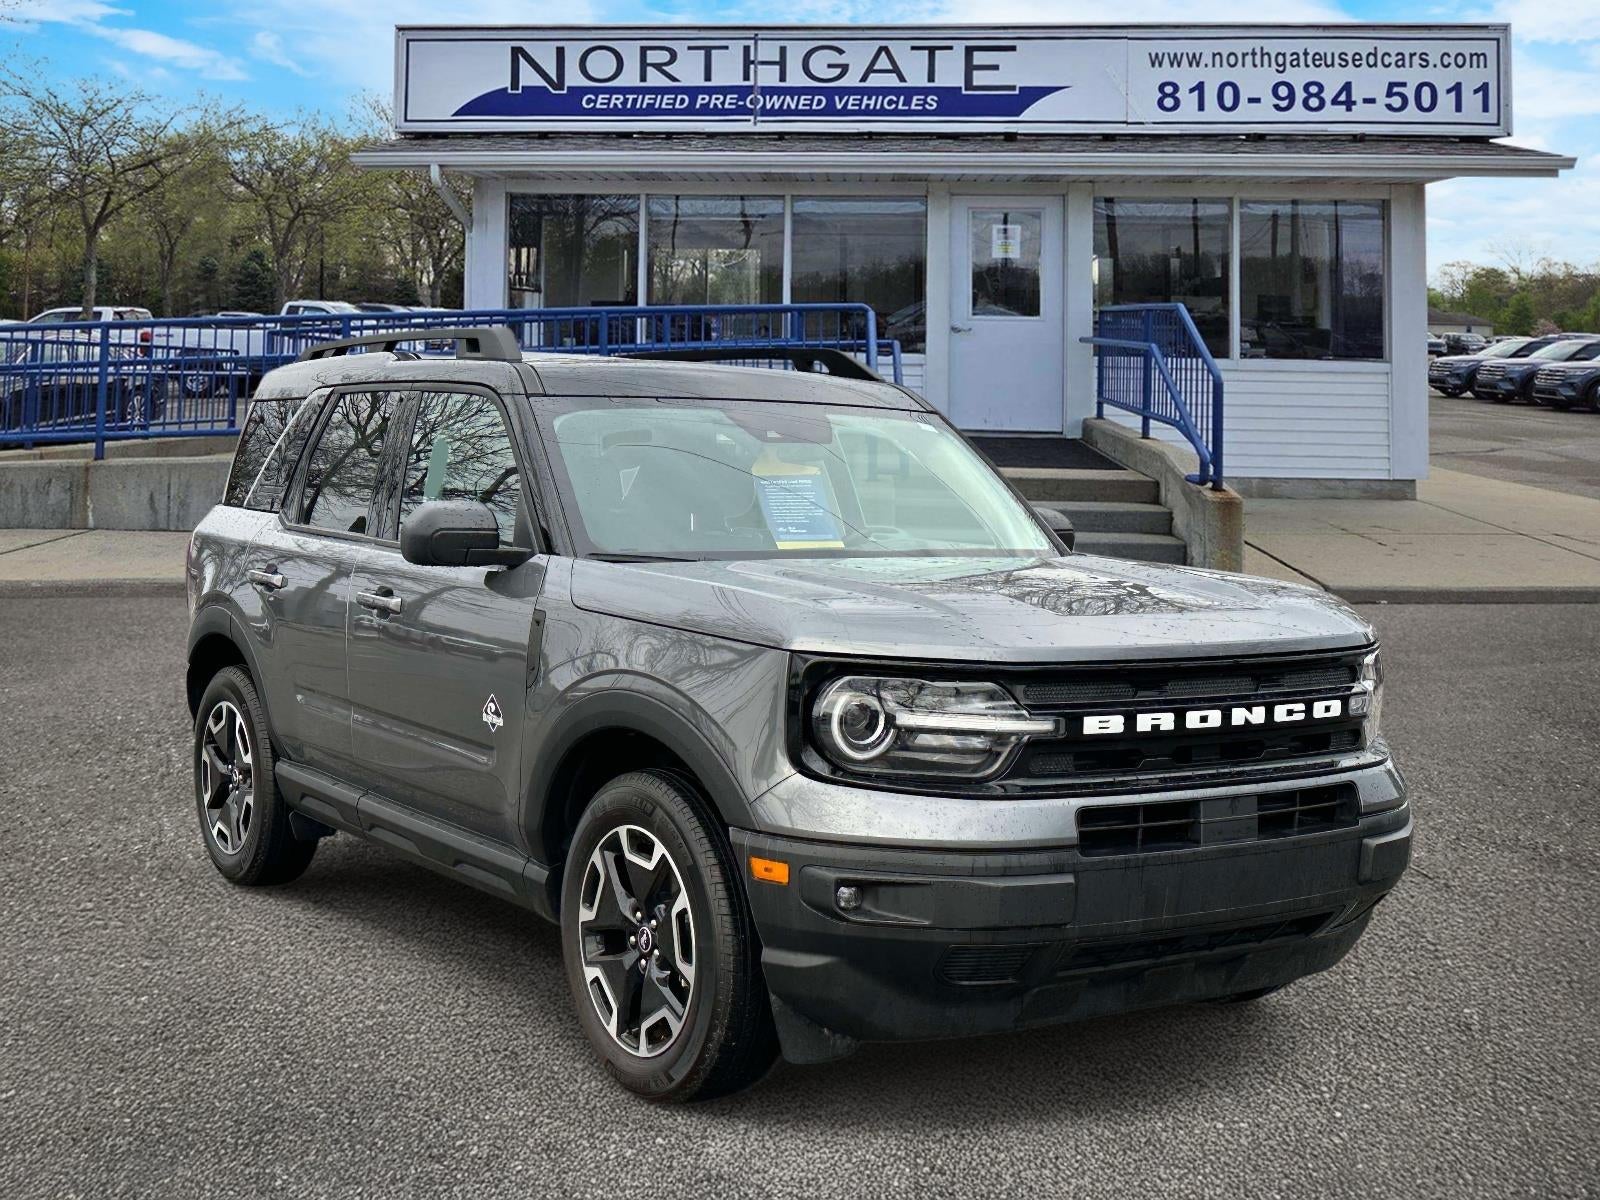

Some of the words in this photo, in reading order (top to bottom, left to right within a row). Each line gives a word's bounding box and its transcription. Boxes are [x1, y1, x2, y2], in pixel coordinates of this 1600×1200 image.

[509, 44, 1018, 93] NORTHGATE
[1148, 46, 1488, 74] www.northgateusedcars.com
[581, 93, 690, 110] CERTIFIED
[695, 93, 828, 110] PRE-OWNED
[834, 94, 940, 111] VEHICLES
[1156, 80, 1491, 114] 810-984-5011
[1082, 699, 1342, 735] BRONCO
